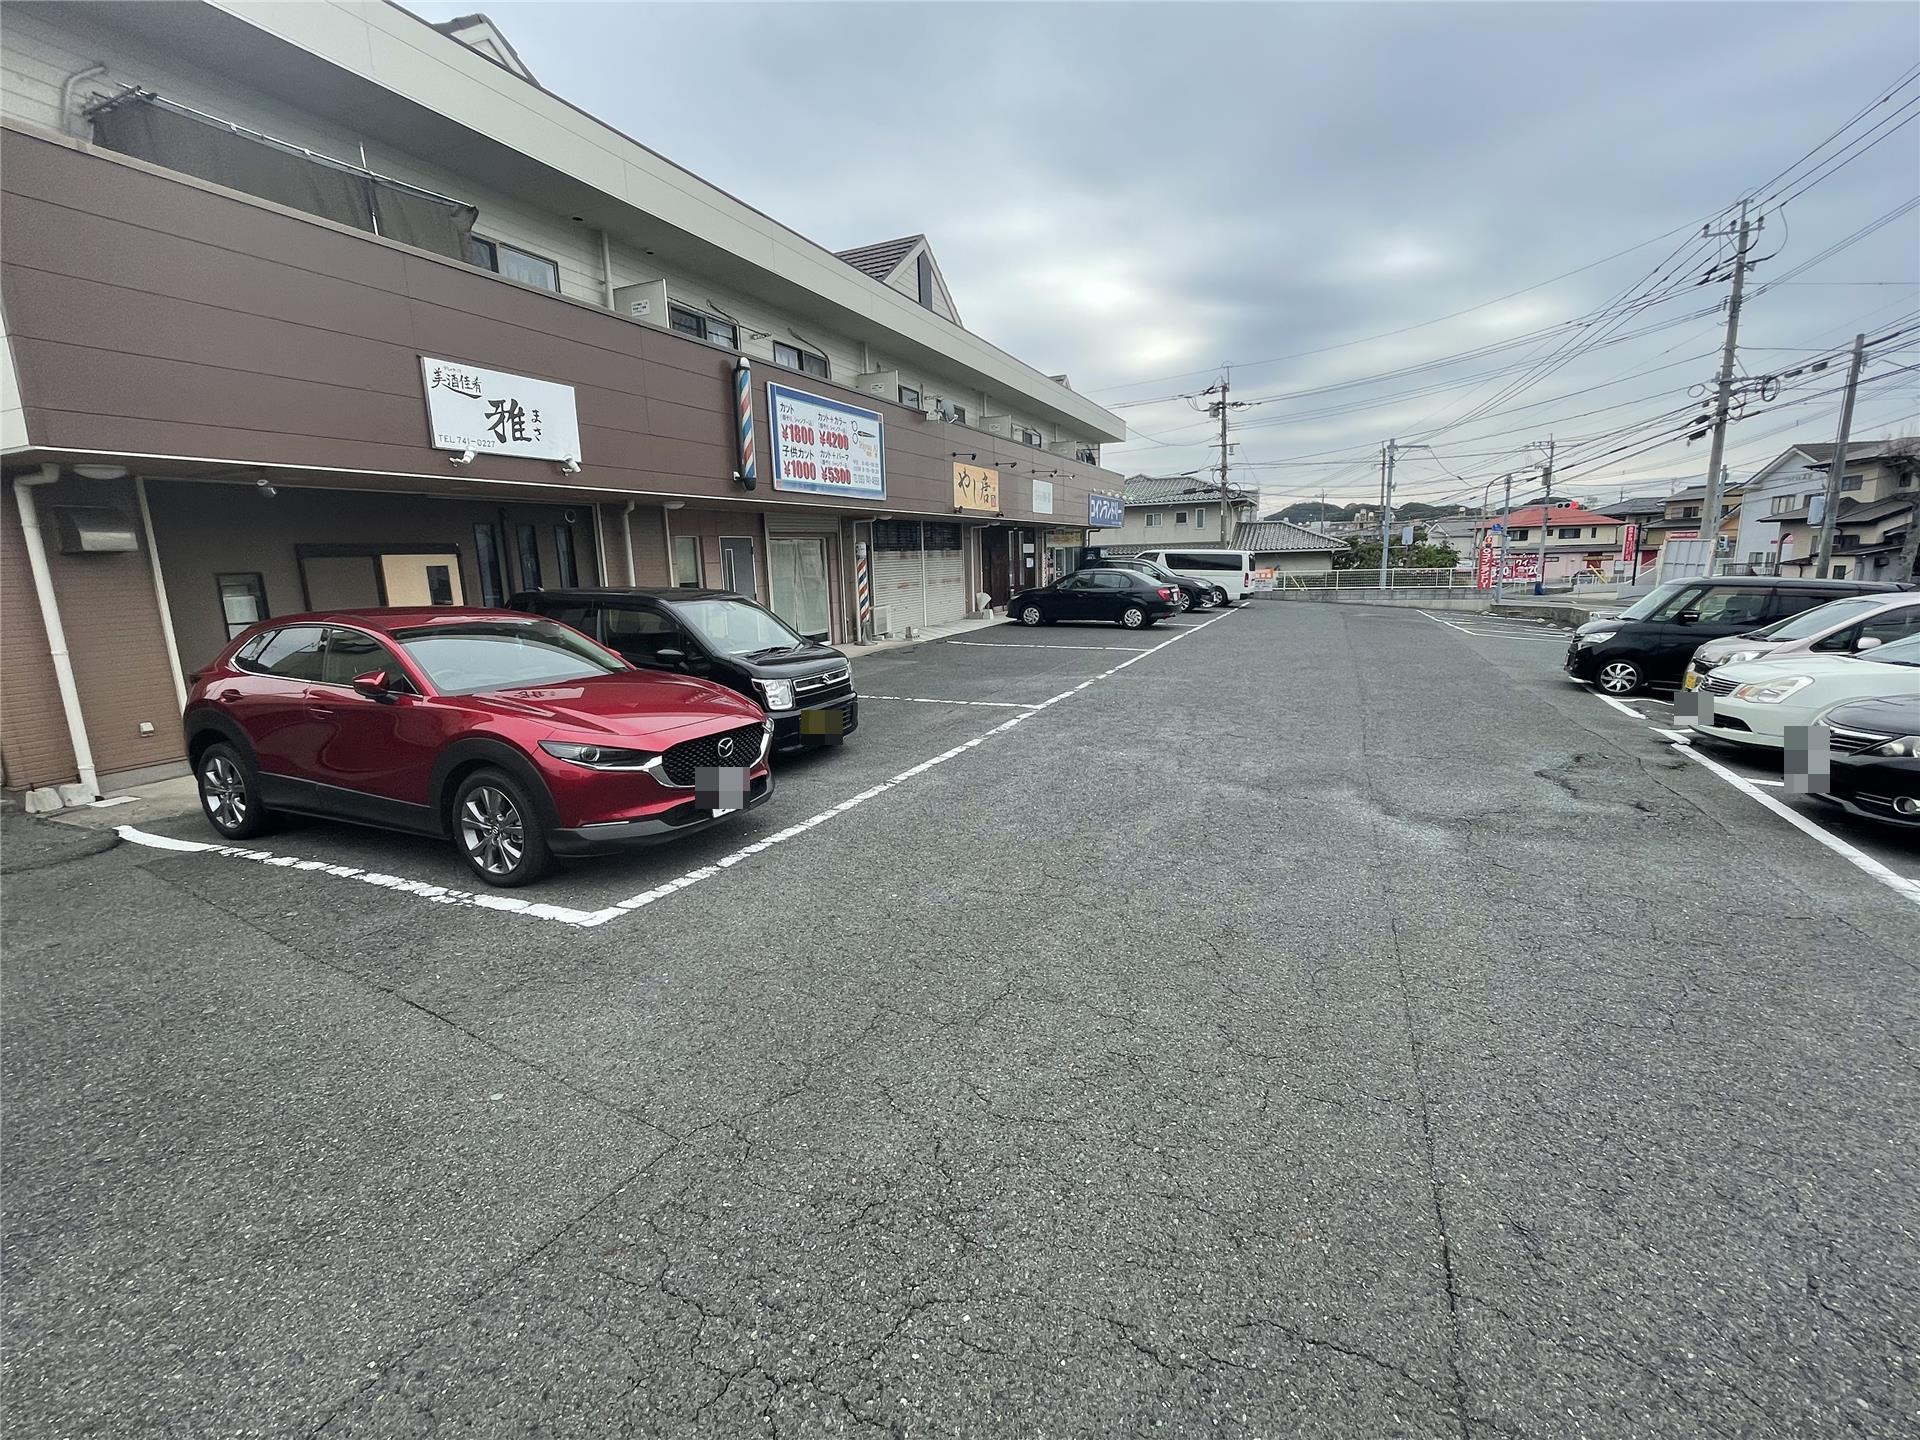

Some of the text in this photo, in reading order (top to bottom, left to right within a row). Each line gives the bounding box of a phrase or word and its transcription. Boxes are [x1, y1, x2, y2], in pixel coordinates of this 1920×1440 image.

[484, 398, 532, 443] 雅
[531, 409, 542, 442] まさ
[438, 434, 456, 444] TEL
[781, 423, 815, 446] ¥1800
[782, 444, 814, 460] 子供カット
[783, 459, 817, 481] ¥1000
